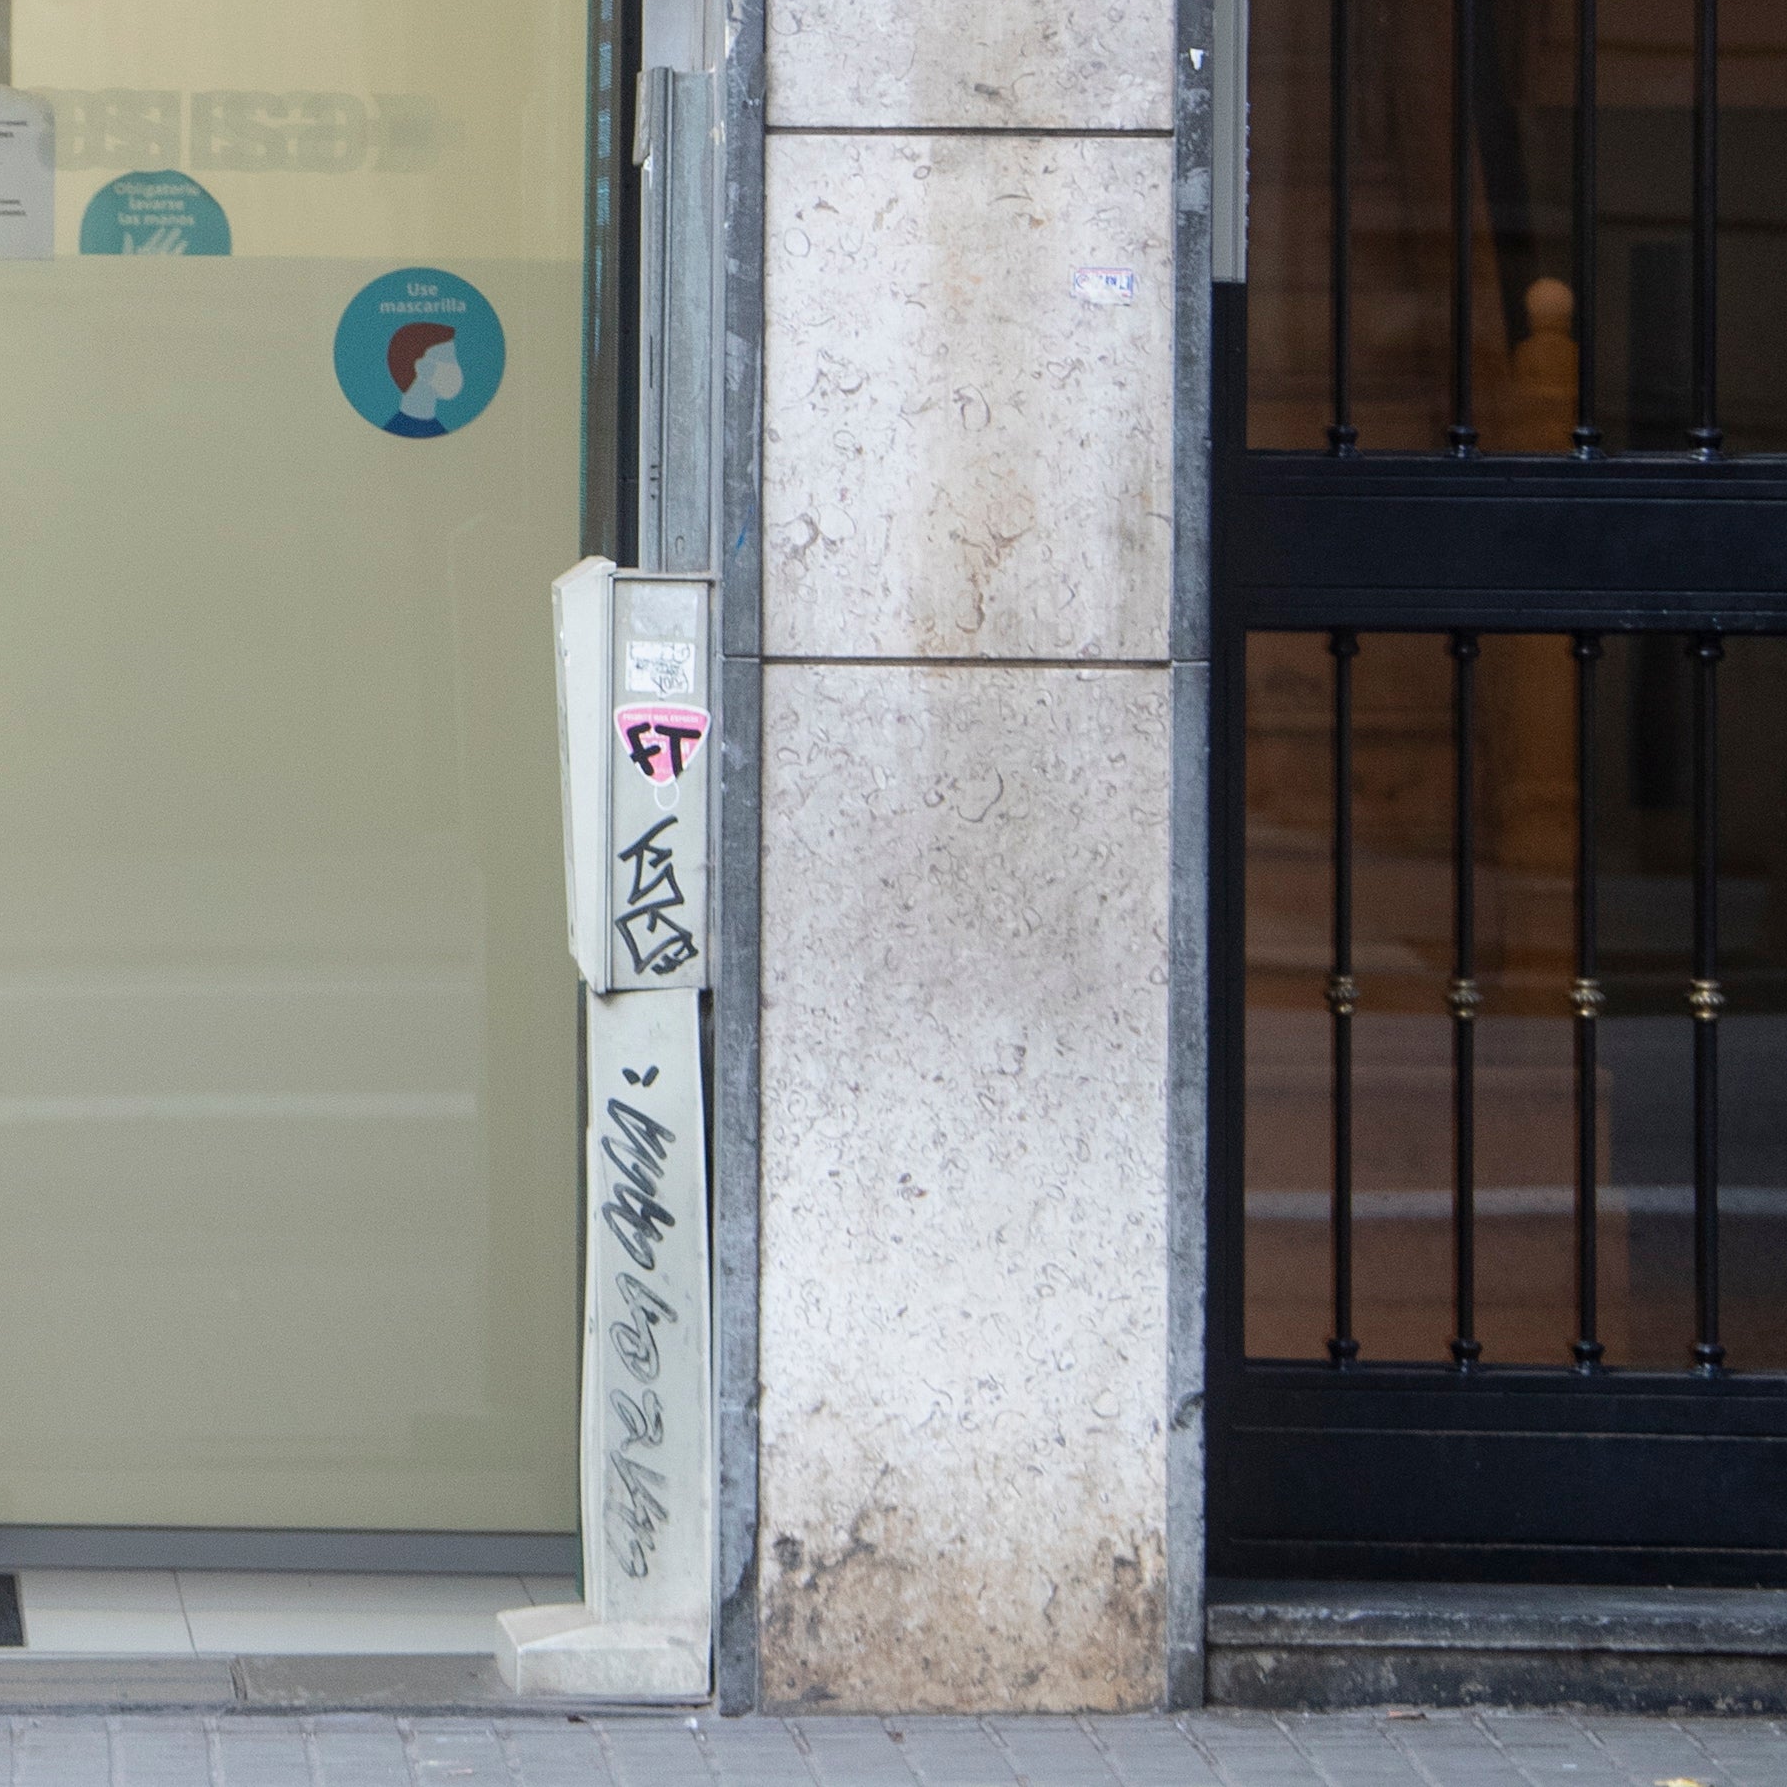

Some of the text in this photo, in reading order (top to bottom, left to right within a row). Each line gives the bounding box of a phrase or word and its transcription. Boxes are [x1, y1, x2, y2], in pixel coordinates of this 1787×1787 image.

[114, 181, 200, 197] Obligatorio
[129, 199, 185, 211] lavarse
[117, 213, 196, 226] las manos
[407, 282, 439, 296] Use
[379, 298, 467, 313] mascarilla
